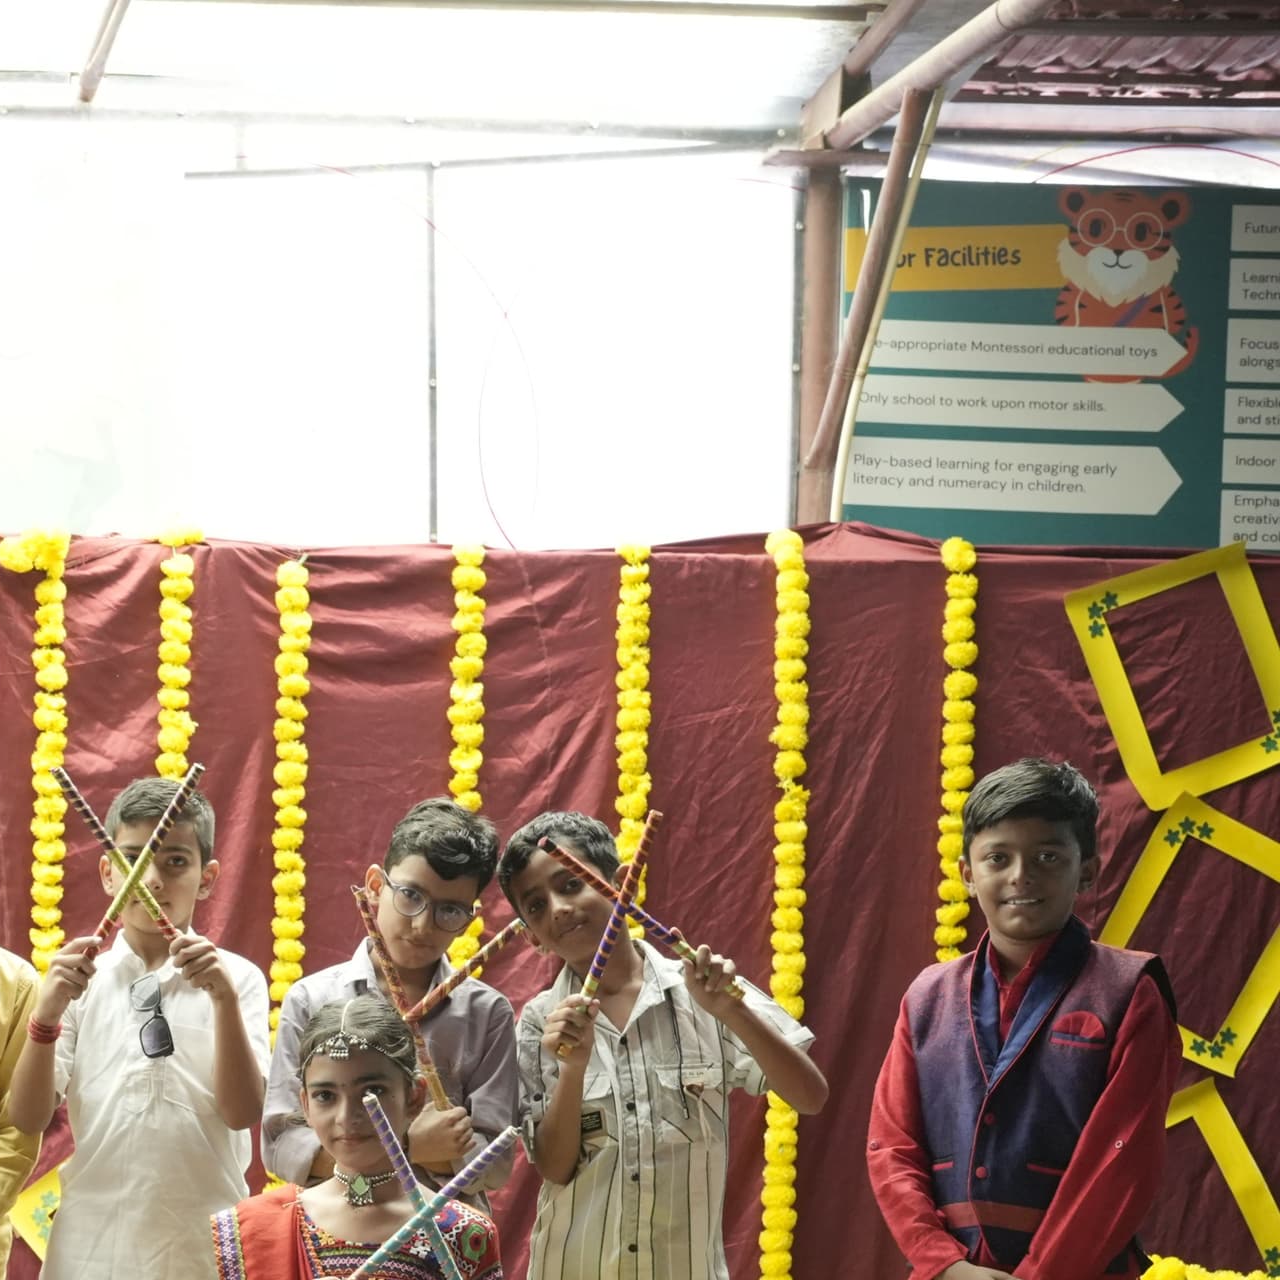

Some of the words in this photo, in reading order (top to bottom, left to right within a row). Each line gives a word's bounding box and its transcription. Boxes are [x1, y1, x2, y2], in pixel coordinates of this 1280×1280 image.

[895, 252, 914, 268] ur
[924, 246, 1021, 268] Facilities
[876, 338, 967, 354] e-appropriate
[971, 340, 1044, 355] Montessori
[1048, 344, 1126, 357] educational
[1129, 345, 1158, 359] toys
[1240, 337, 1279, 350] Focus
[859, 392, 889, 407] Only
[892, 392, 936, 406] school
[940, 395, 953, 407] to
[957, 395, 988, 408] work
[991, 398, 1025, 413] upon
[1029, 399, 1069, 411] motor
[1072, 400, 1106, 413] skills.
[1237, 414, 1261, 425] and
[853, 453, 933, 470] Play-based
[936, 457, 990, 473] learning
[994, 459, 1012, 472] for
[1018, 462, 1079, 477] engaging
[1083, 463, 1117, 478] early
[1235, 455, 1276, 467] Indoor
[853, 472, 903, 489] literacy
[908, 475, 934, 488] and
[939, 477, 1008, 492] numeracy
[1011, 478, 1023, 491] in
[1027, 480, 1086, 493] children.
[1233, 530, 1258, 542] and
